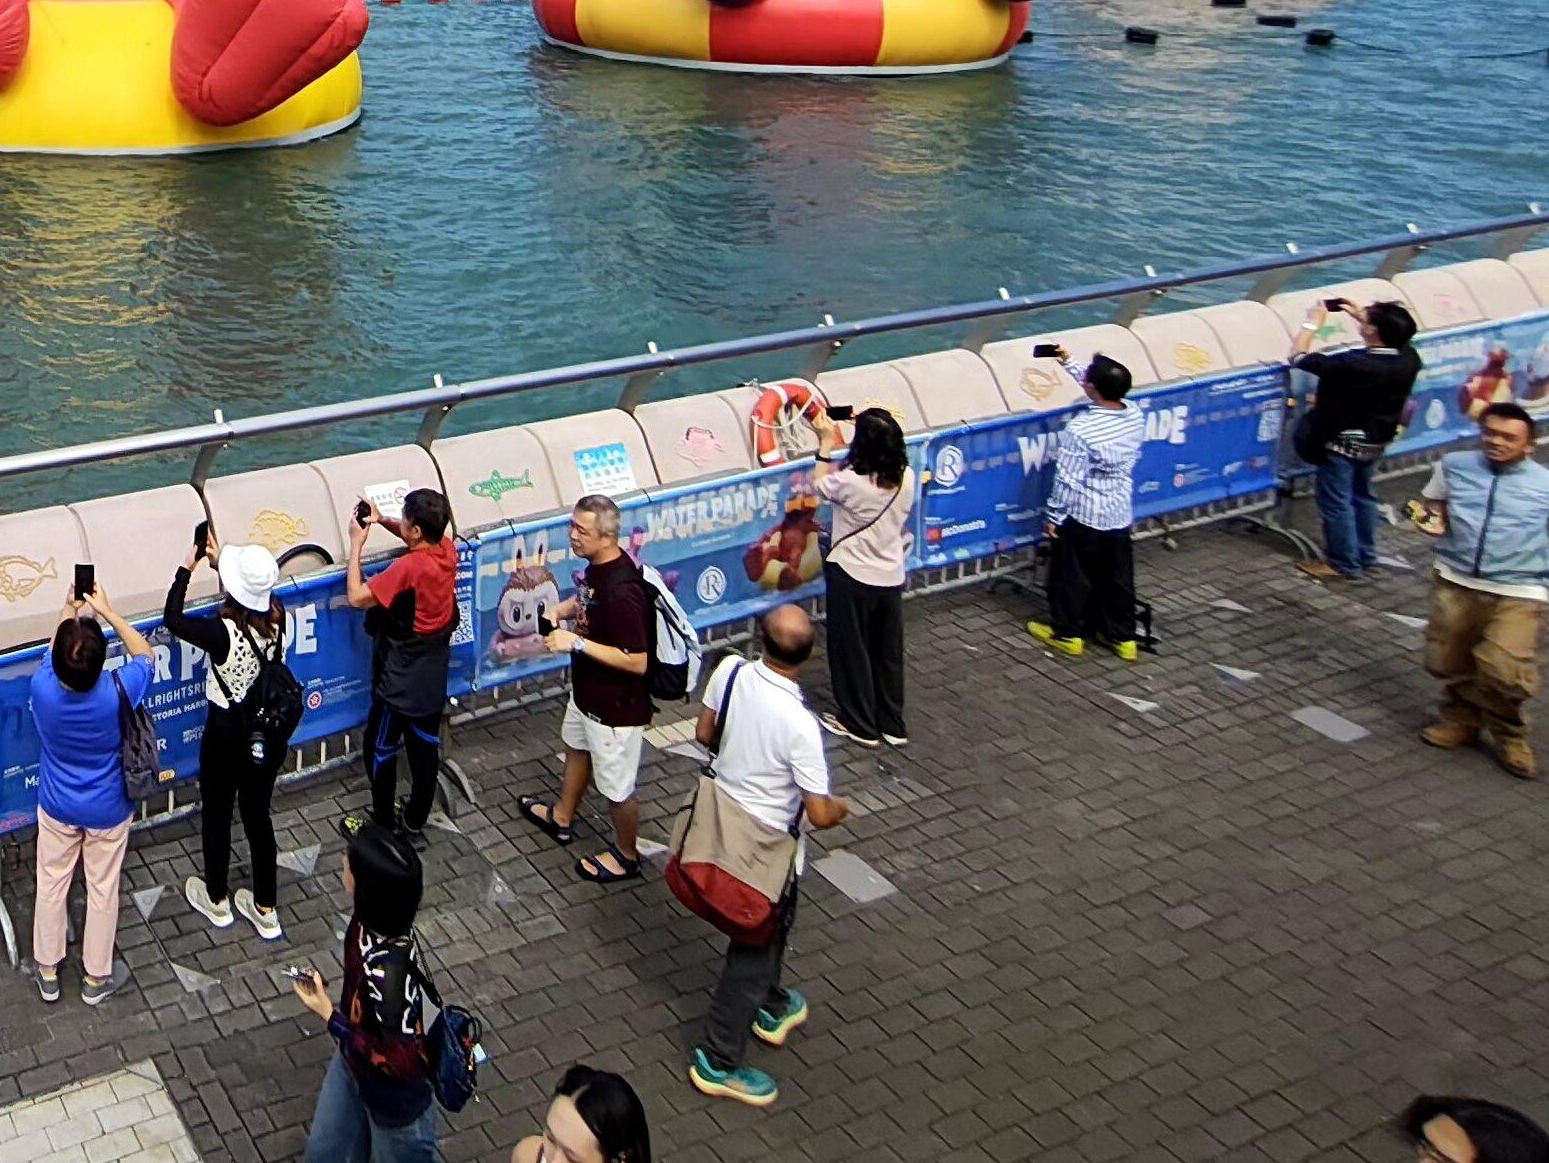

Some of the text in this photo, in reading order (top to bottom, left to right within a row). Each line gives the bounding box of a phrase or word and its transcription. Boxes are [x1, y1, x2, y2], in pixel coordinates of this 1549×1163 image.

[1143, 405, 1189, 445] ADE
[646, 483, 780, 541] WATER PARADE
